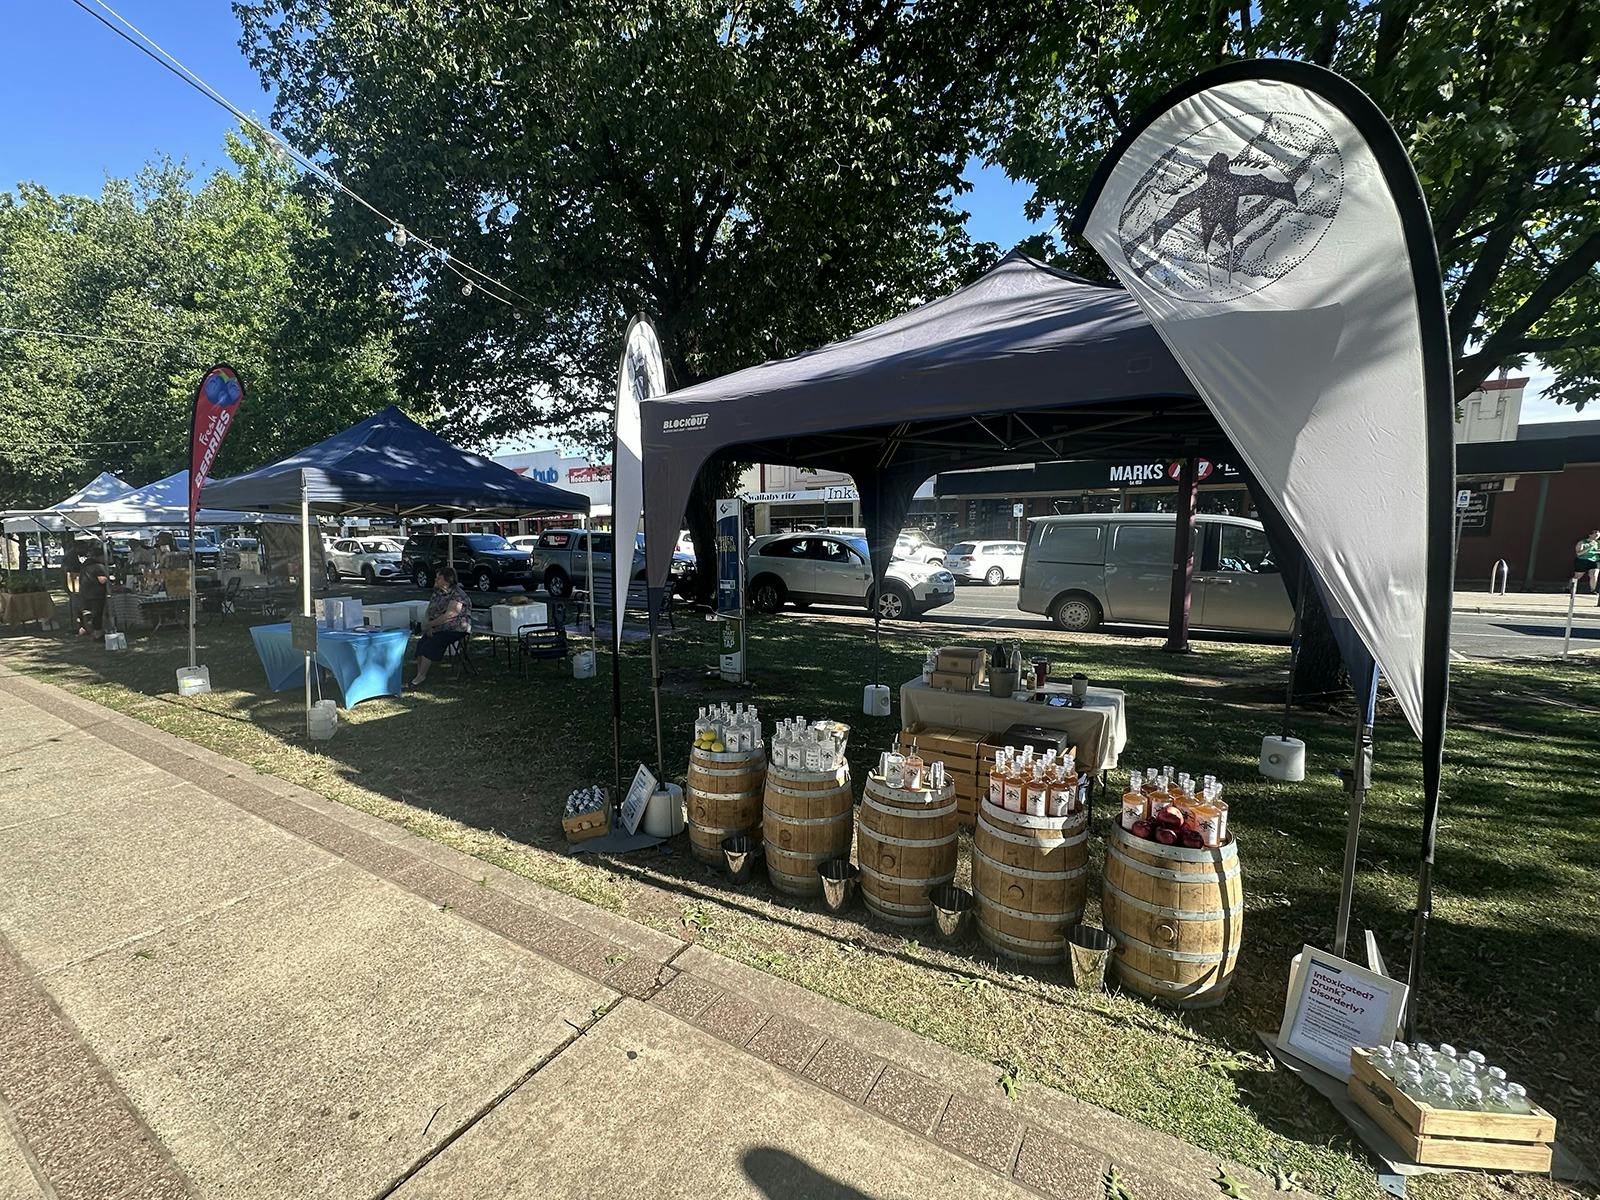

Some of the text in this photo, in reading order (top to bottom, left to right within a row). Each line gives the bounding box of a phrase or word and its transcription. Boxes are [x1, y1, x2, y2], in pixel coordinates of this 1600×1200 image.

[198, 415, 218, 446] Fresh
[663, 416, 709, 429] BLOCKOUT
[195, 410, 230, 488] BERRIES
[533, 466, 559, 484] hub
[1109, 464, 1164, 481] MARKS
[781, 492, 797, 500] ritz
[828, 487, 852, 500] Ink
[1311, 979, 1346, 998] Drunk?
[1313, 971, 1375, 1001] Intoxicated?
[1310, 986, 1365, 1015] Disorderly?
